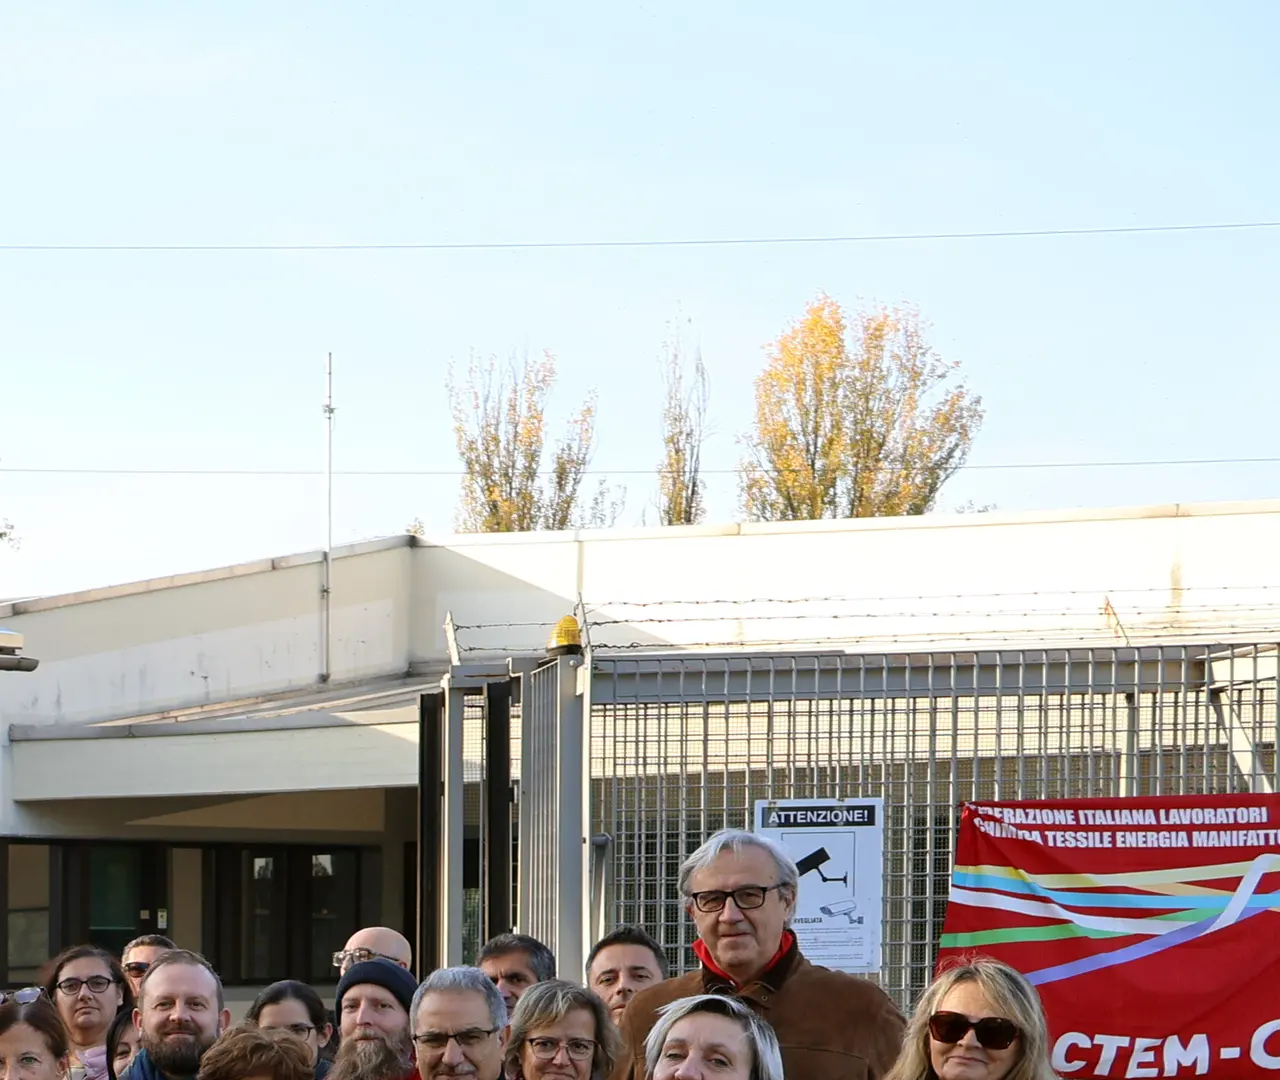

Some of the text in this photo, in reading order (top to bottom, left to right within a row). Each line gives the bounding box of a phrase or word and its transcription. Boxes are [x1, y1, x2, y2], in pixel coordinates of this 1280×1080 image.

[768, 810, 868, 824] ATTENZIONE!
[1079, 808, 1157, 825] ITALIANA
[1159, 807, 1268, 824] LAVORATORI
[1044, 830, 1112, 848] TESSILE
[1116, 831, 1189, 848] ENERGIA
